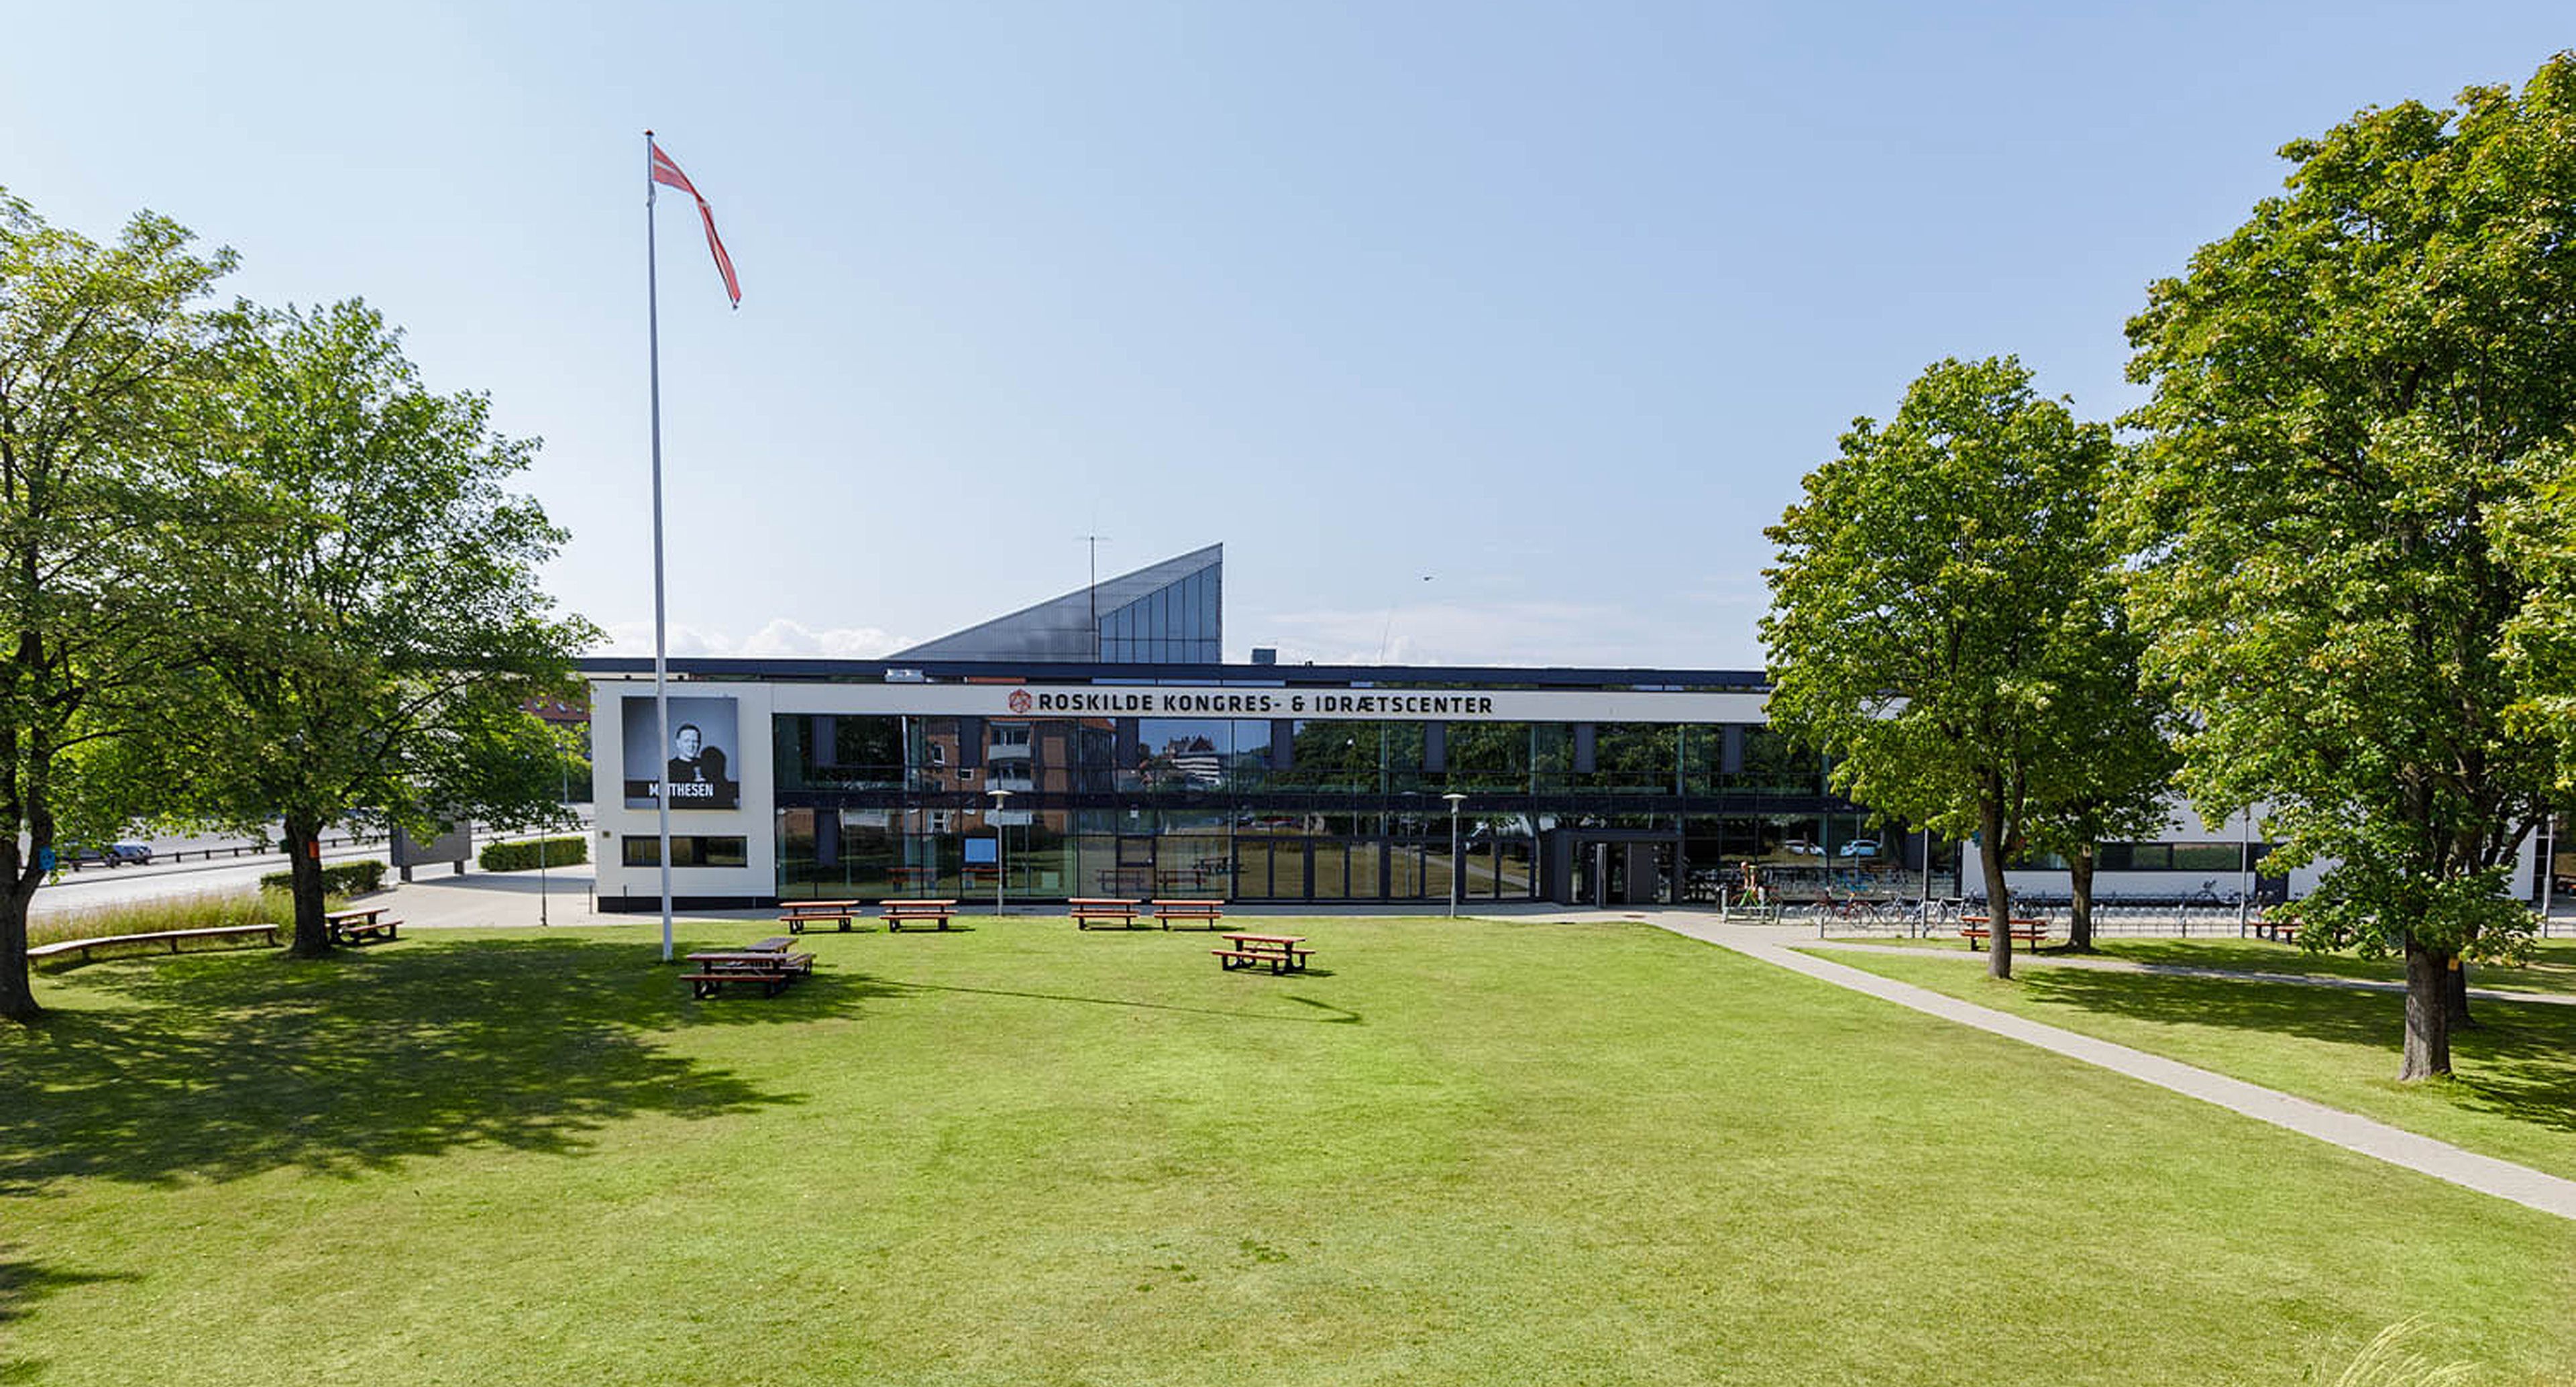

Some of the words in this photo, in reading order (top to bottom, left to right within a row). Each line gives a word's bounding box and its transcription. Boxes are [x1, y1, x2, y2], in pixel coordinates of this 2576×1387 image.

[1040, 694, 1152, 710] ROSKILDE
[1164, 695, 1281, 712] KONGRES-
[1292, 696, 1305, 712] &
[1316, 696, 1492, 713] IDRÆTSCENTER
[649, 783, 714, 796] MTTHESEN
